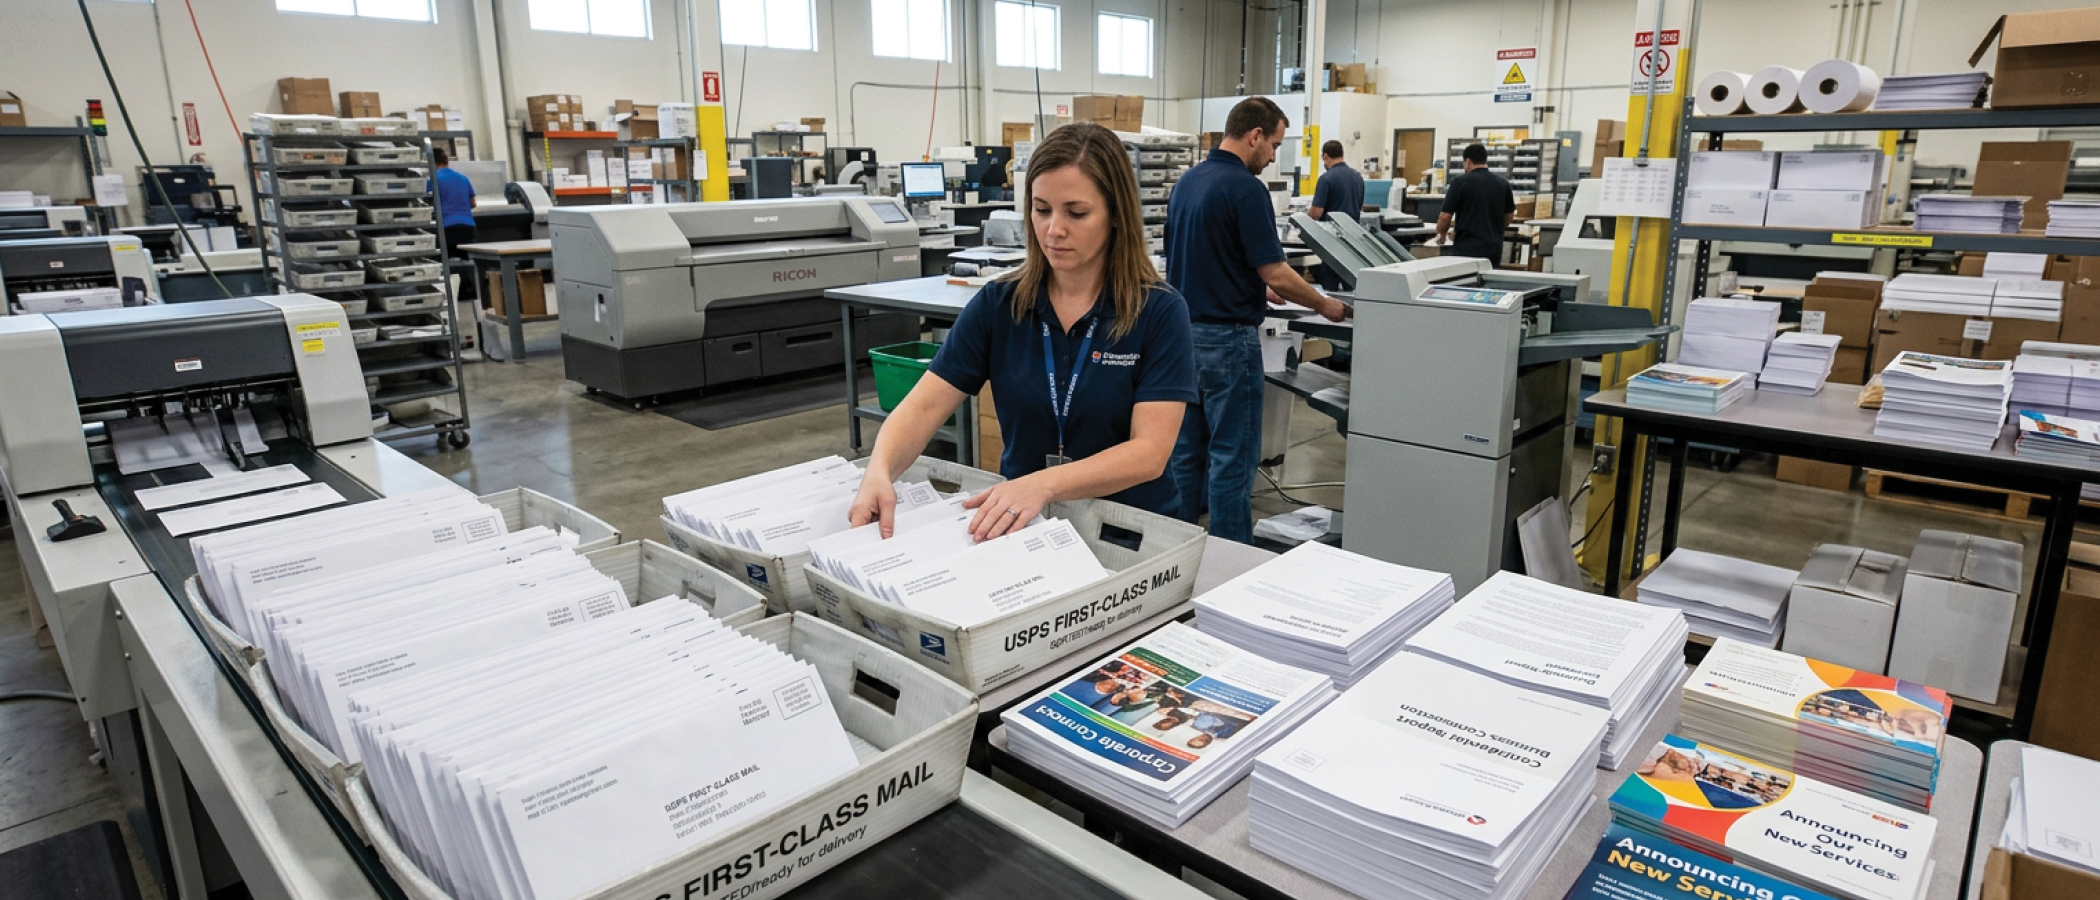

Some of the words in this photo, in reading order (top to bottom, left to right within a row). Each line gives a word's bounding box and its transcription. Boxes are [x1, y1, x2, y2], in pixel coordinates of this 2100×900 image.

[773, 268, 816, 282] RICON
[1004, 621, 1050, 652] USPS
[1054, 580, 1148, 632] FIRST-CLASS
[1151, 564, 1182, 589] MAIL
[684, 793, 869, 900] FIRST-CLASS
[876, 761, 934, 807] MAIL
[1764, 827, 1810, 850] New
[1780, 809, 1908, 860] Announcing
[1815, 833, 1856, 853] Our
[1607, 849, 1672, 883] New
[1615, 836, 1775, 900] Announcing
